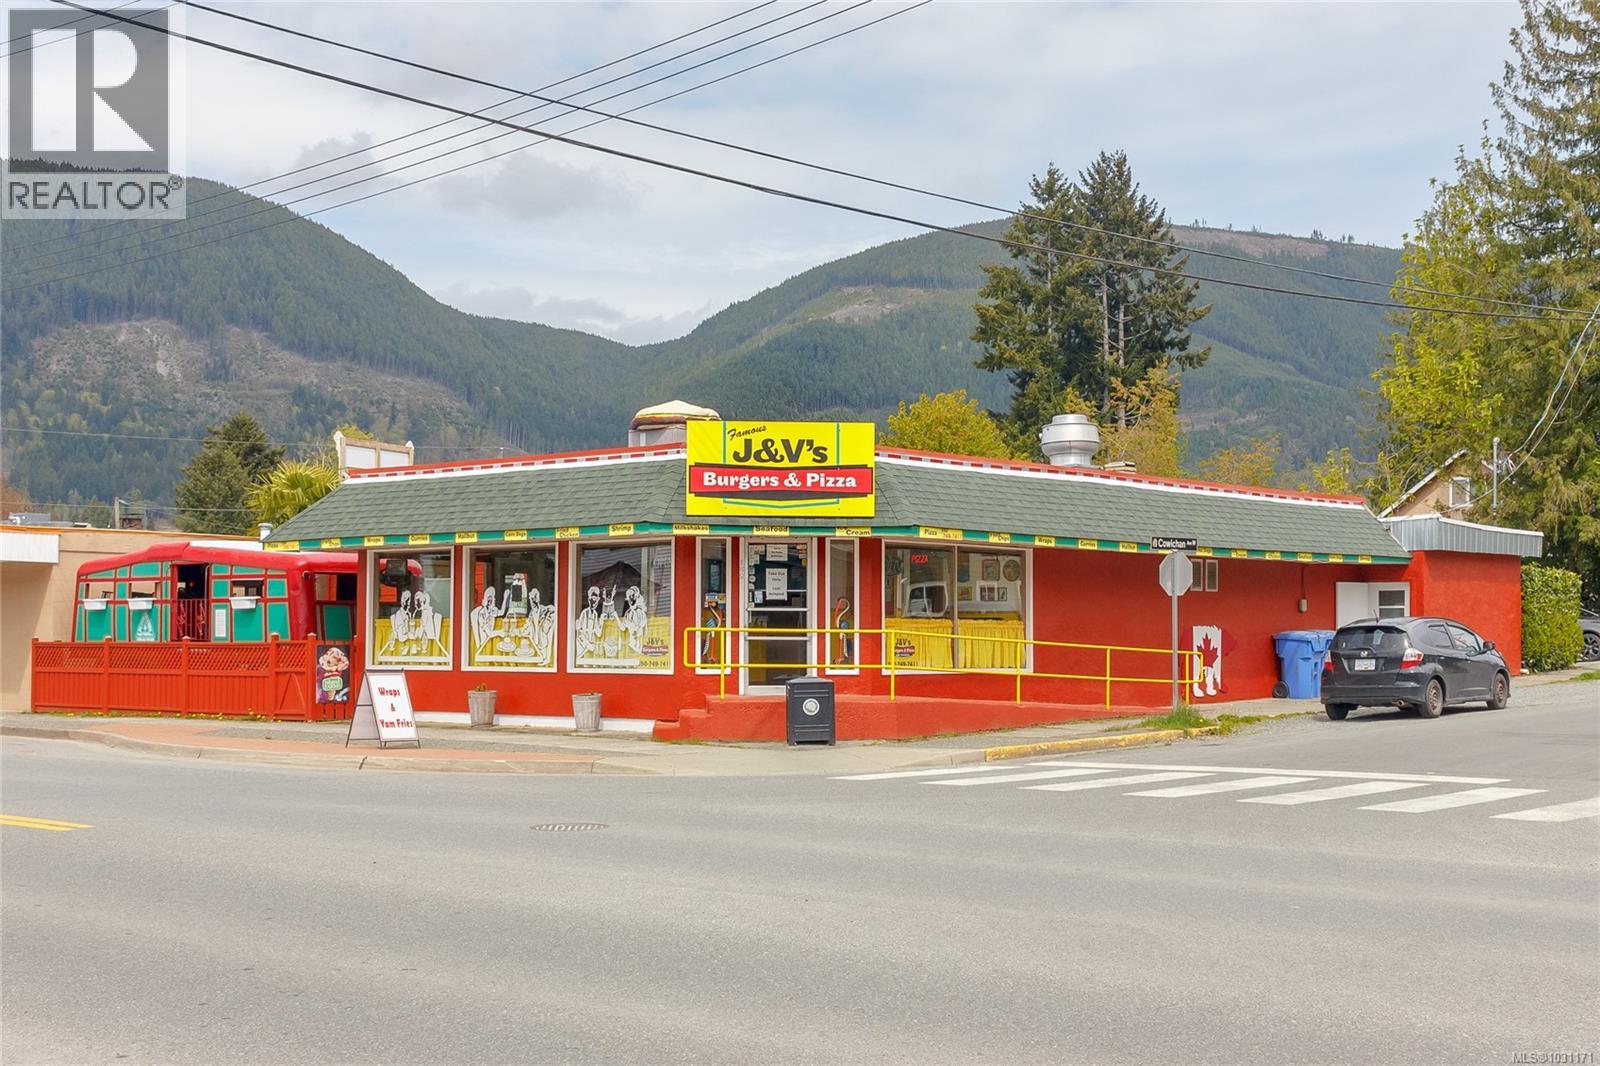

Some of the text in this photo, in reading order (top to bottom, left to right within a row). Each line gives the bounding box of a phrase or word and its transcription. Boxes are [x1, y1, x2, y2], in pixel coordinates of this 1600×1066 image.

[727, 425, 767, 440] Famous
[732, 438, 828, 463] J&V's
[703, 472, 857, 490] Burgers & Pizza
[924, 528, 938, 536] Pizza
[1158, 538, 1186, 548] Cowichan
[646, 637, 664, 645] J&V's
[378, 687, 400, 696] Wraps
[390, 703, 396, 712] &
[380, 719, 413, 728] Yam Fries
